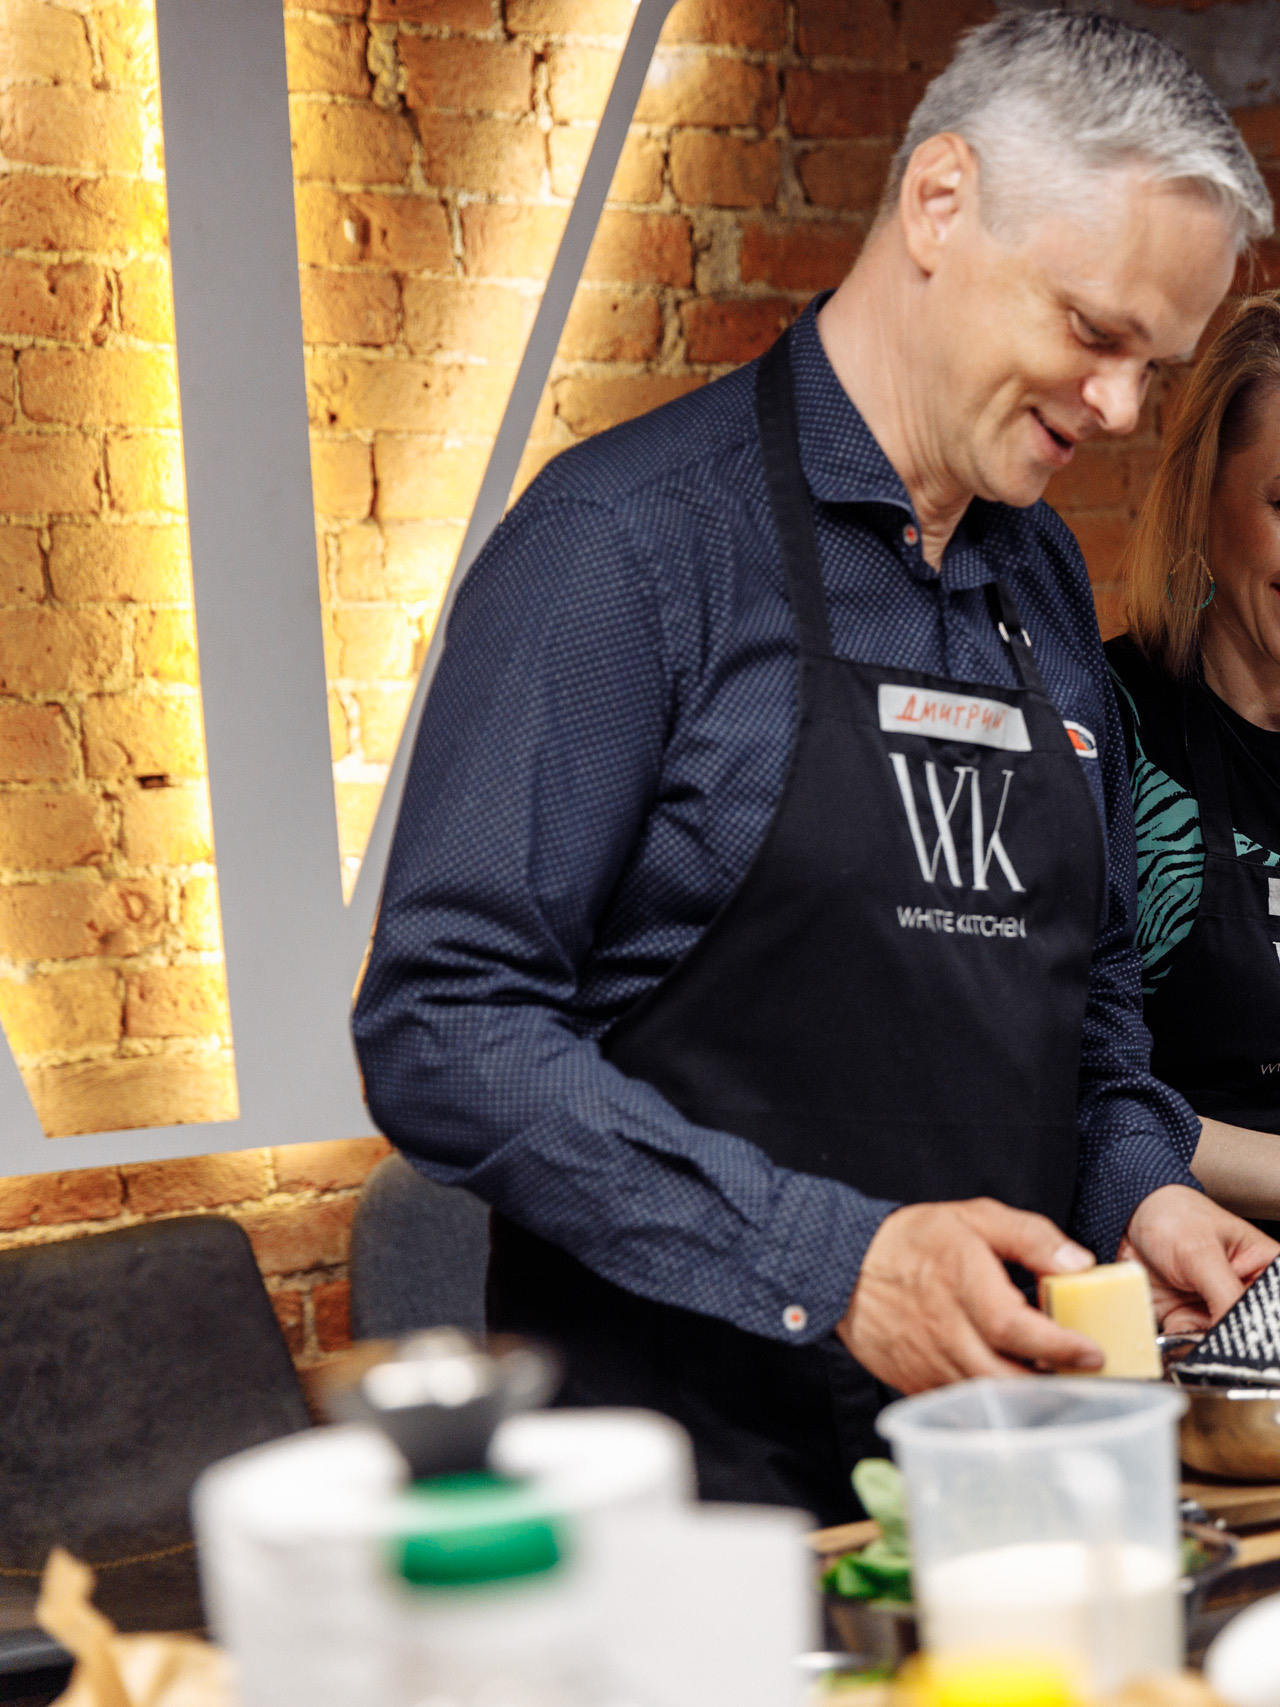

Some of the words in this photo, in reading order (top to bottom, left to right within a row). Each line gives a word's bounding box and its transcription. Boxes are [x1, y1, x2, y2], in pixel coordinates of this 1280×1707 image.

[888, 752, 1026, 892] WK
[897, 905, 955, 934] WHITE
[957, 914, 1027, 938] KITCHEN
